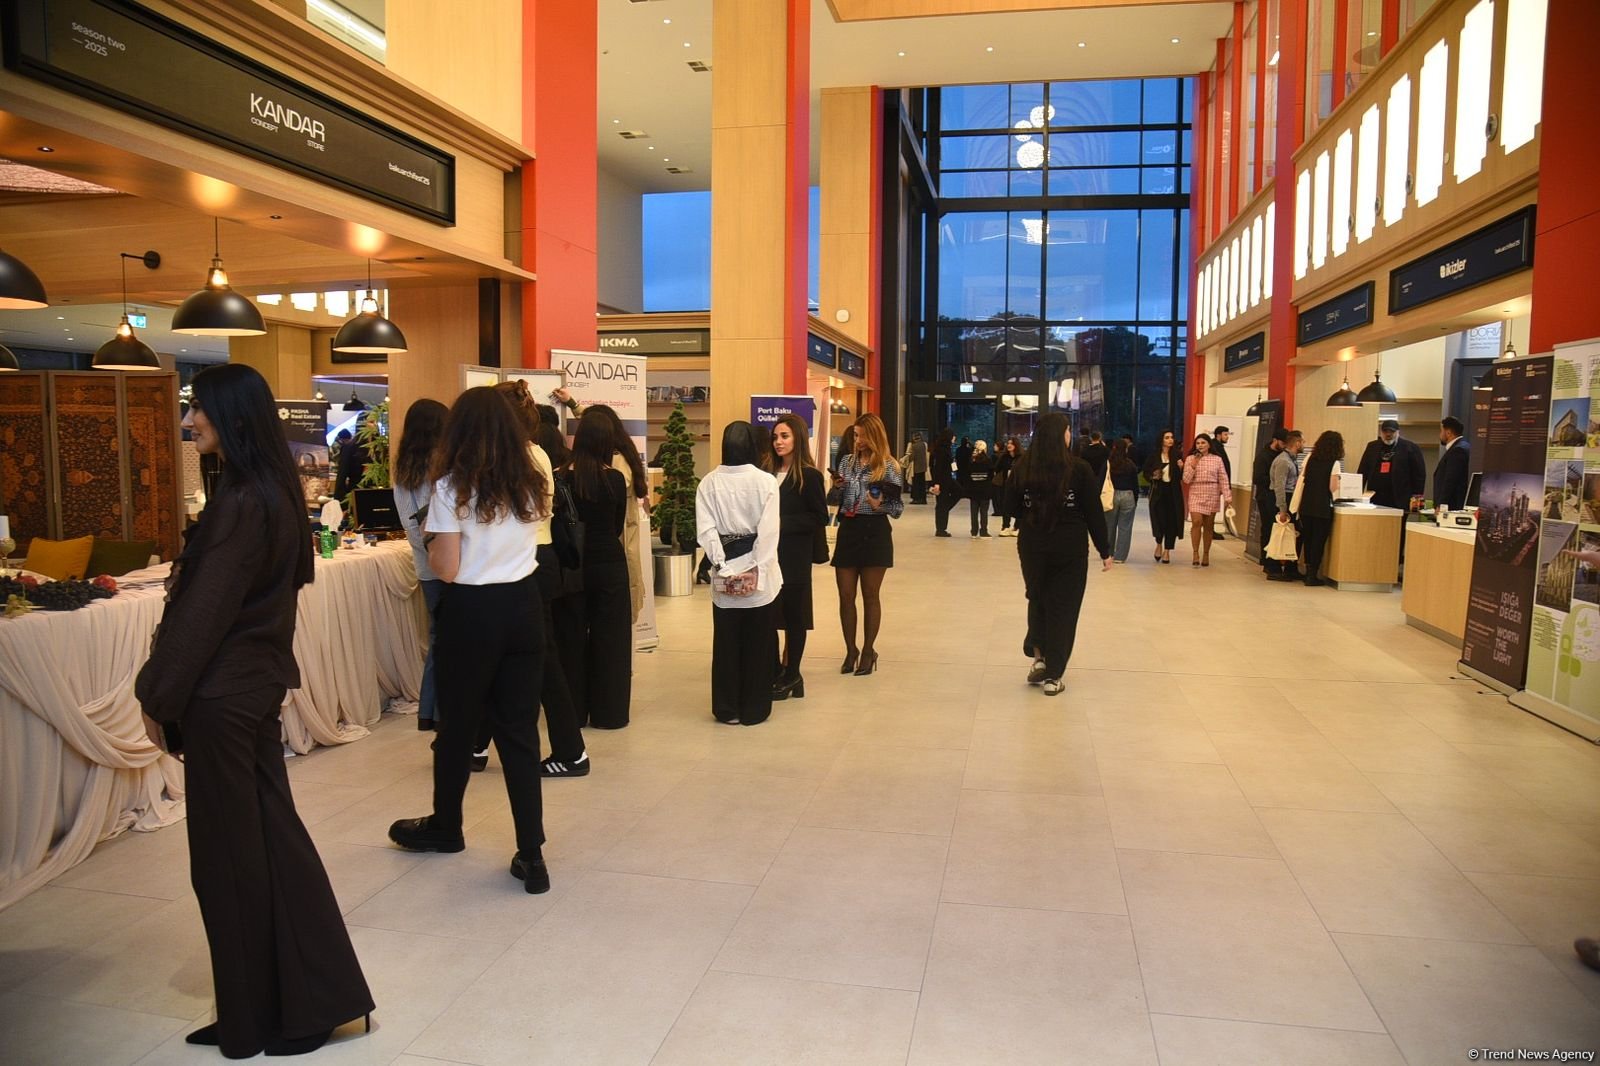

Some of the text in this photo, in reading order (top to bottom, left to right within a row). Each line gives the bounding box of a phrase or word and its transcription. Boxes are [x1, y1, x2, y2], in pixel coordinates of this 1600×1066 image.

[72, 22, 126, 51] season two
[84, 39, 108, 56] 2025
[250, 92, 325, 142] KANDAR
[250, 116, 279, 133] CONCEPT
[561, 360, 638, 382] KANDAR
[773, 407, 792, 415] Baku
[1496, 626, 1520, 645] WORTH
[1495, 637, 1508, 652] THE
[1493, 649, 1512, 666] LIGHT
